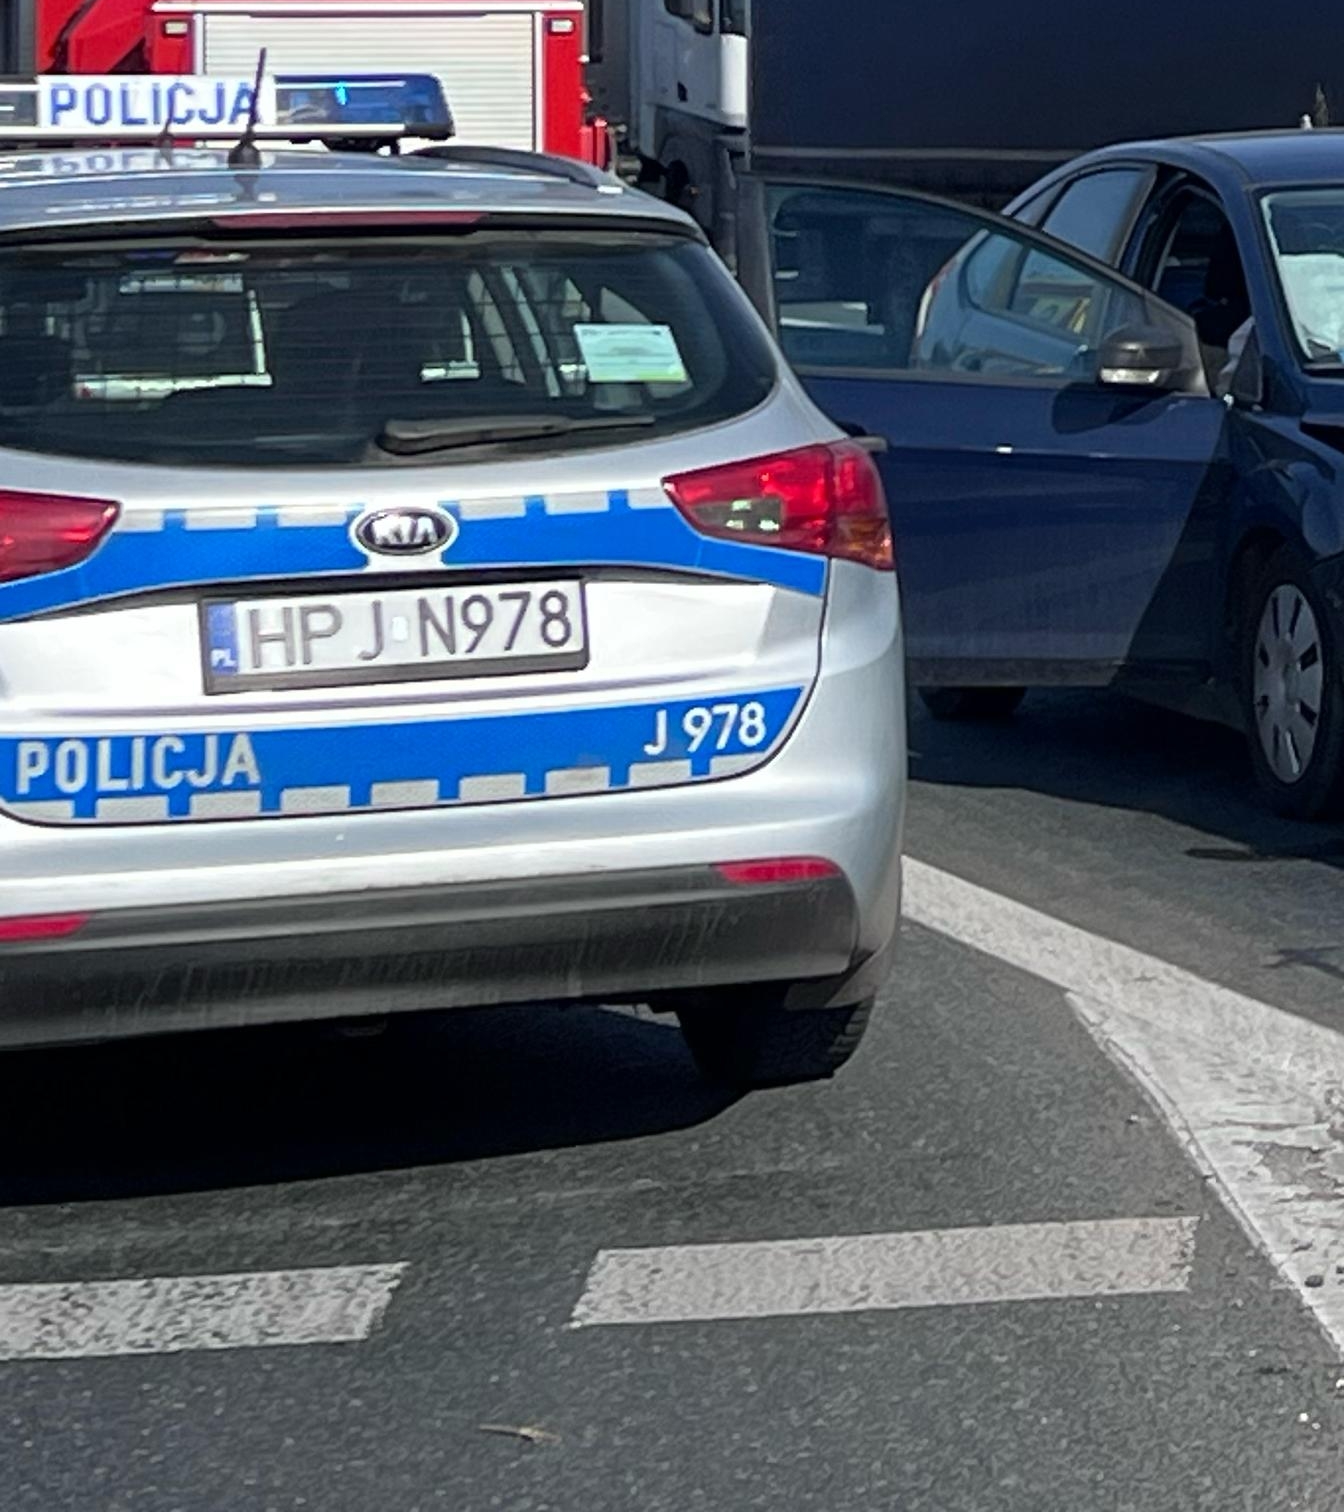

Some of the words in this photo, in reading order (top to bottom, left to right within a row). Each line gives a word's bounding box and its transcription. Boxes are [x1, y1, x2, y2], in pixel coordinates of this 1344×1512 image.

[50, 82, 261, 125] POLICJA
[372, 515, 438, 545] KIA
[418, 590, 572, 656] N978
[211, 649, 236, 667] PL
[644, 709, 668, 755] J
[682, 701, 767, 752] 978
[15, 732, 261, 794] POLICJA
